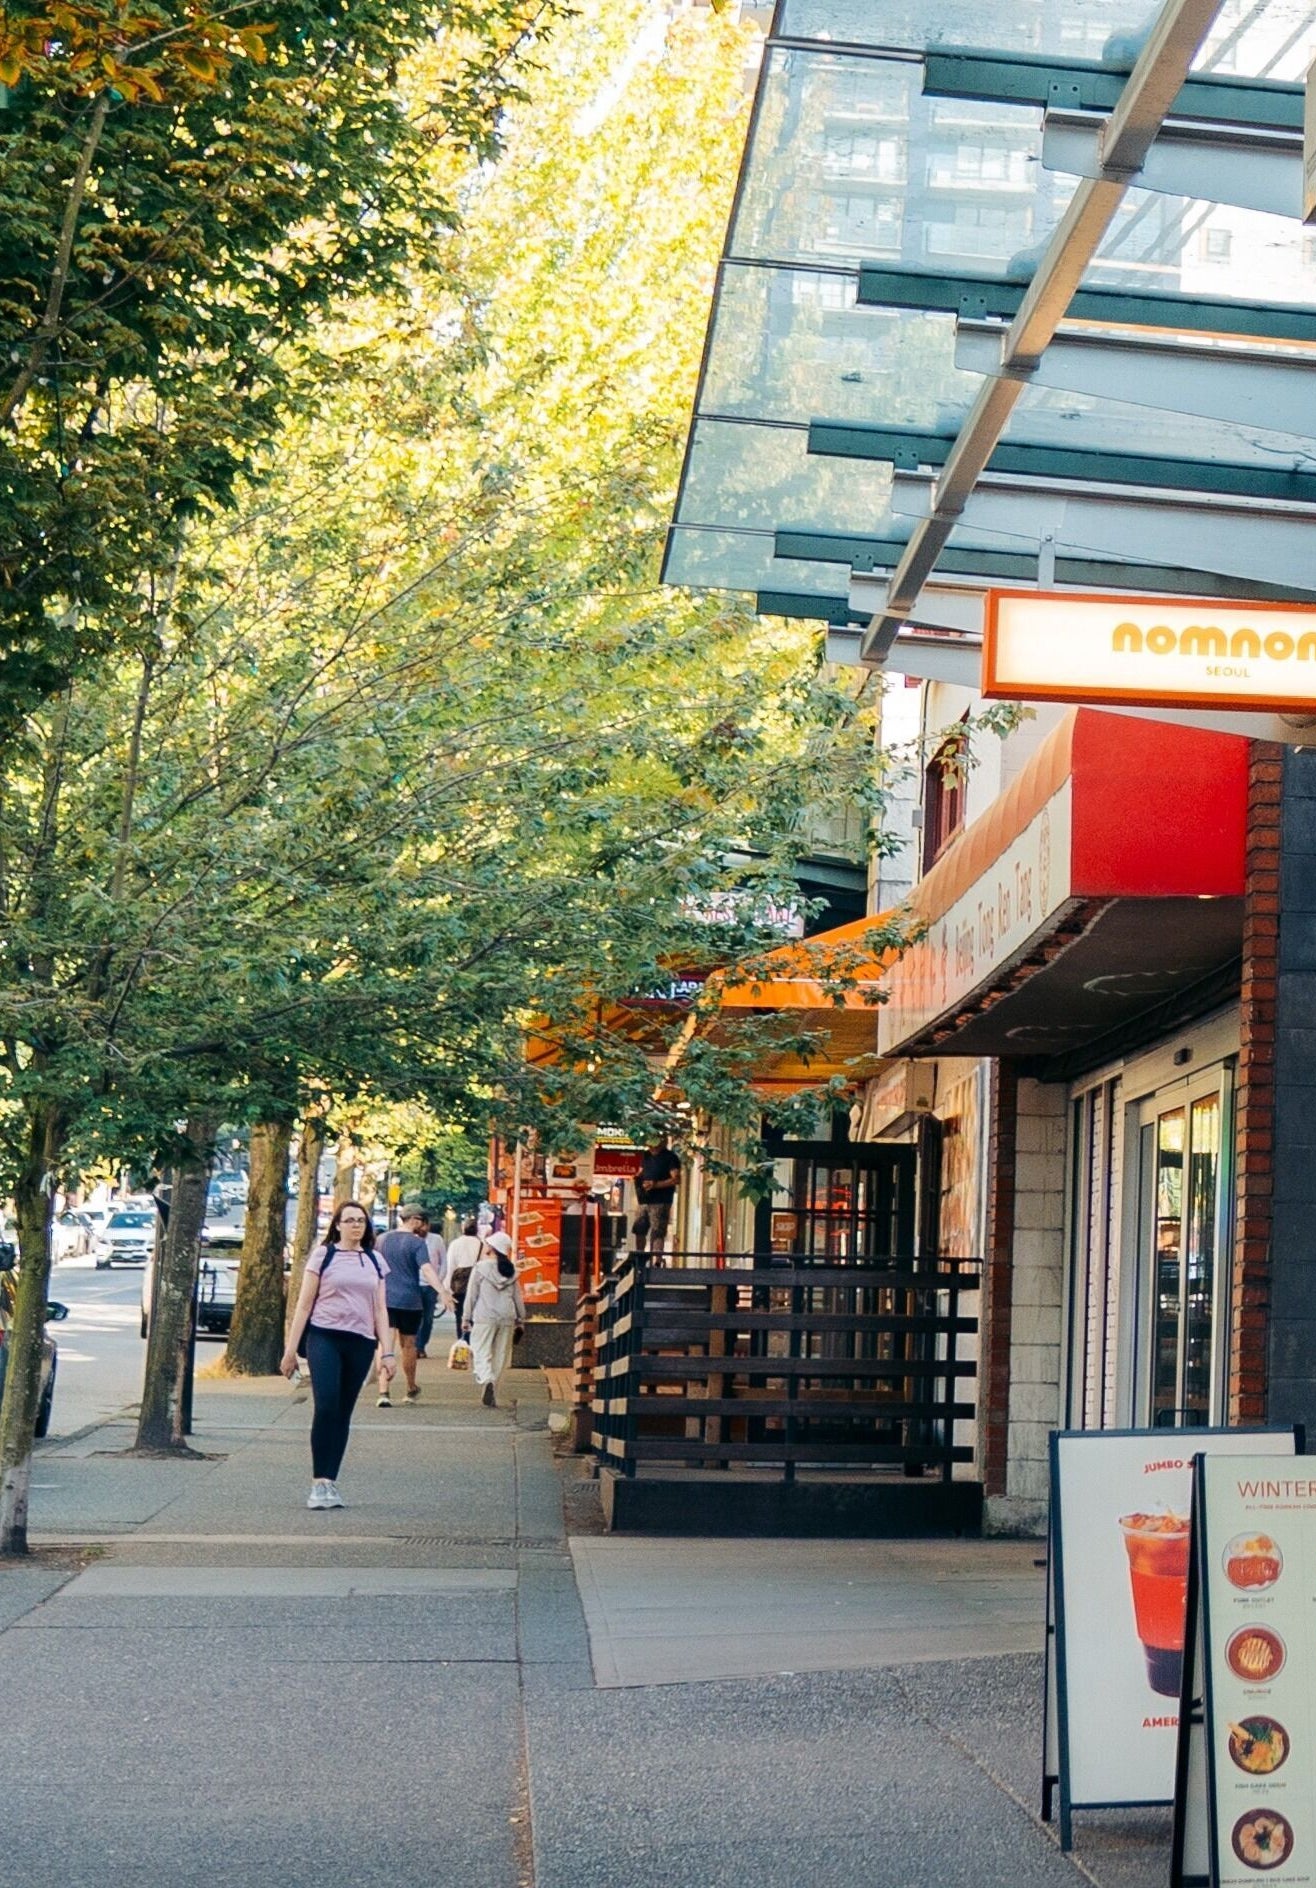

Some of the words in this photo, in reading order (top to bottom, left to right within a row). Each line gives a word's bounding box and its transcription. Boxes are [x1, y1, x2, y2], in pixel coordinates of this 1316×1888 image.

[1205, 666, 1251, 678] SEOUL
[978, 902, 995, 960] Tong
[1015, 861, 1032, 923] Tang
[1144, 1459, 1184, 1474] JUMBO
